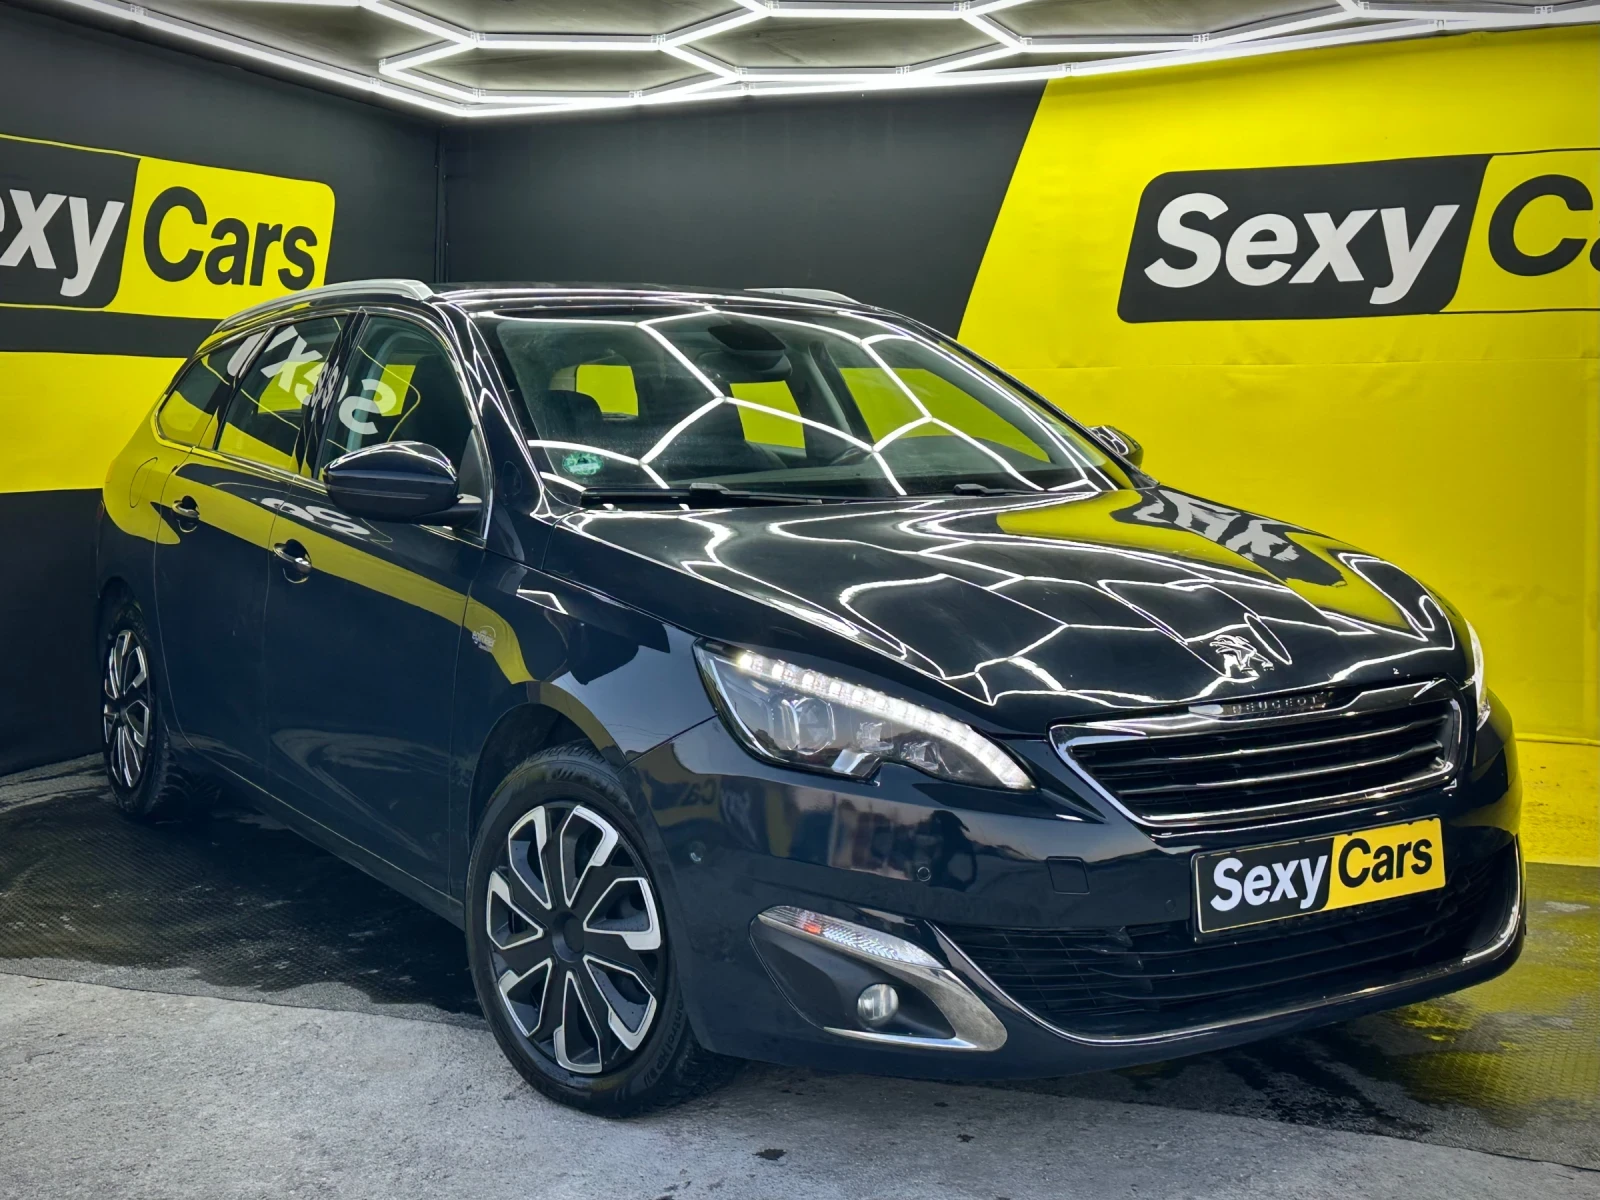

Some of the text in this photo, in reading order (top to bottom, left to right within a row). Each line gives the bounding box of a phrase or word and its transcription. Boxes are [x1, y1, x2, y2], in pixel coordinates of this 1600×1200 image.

[0, 185, 318, 297] xy Cars
[1143, 173, 1600, 305] Sexy C
[1210, 837, 1433, 912] Sexy Cars
[664, 997, 685, 1051] ontrol
